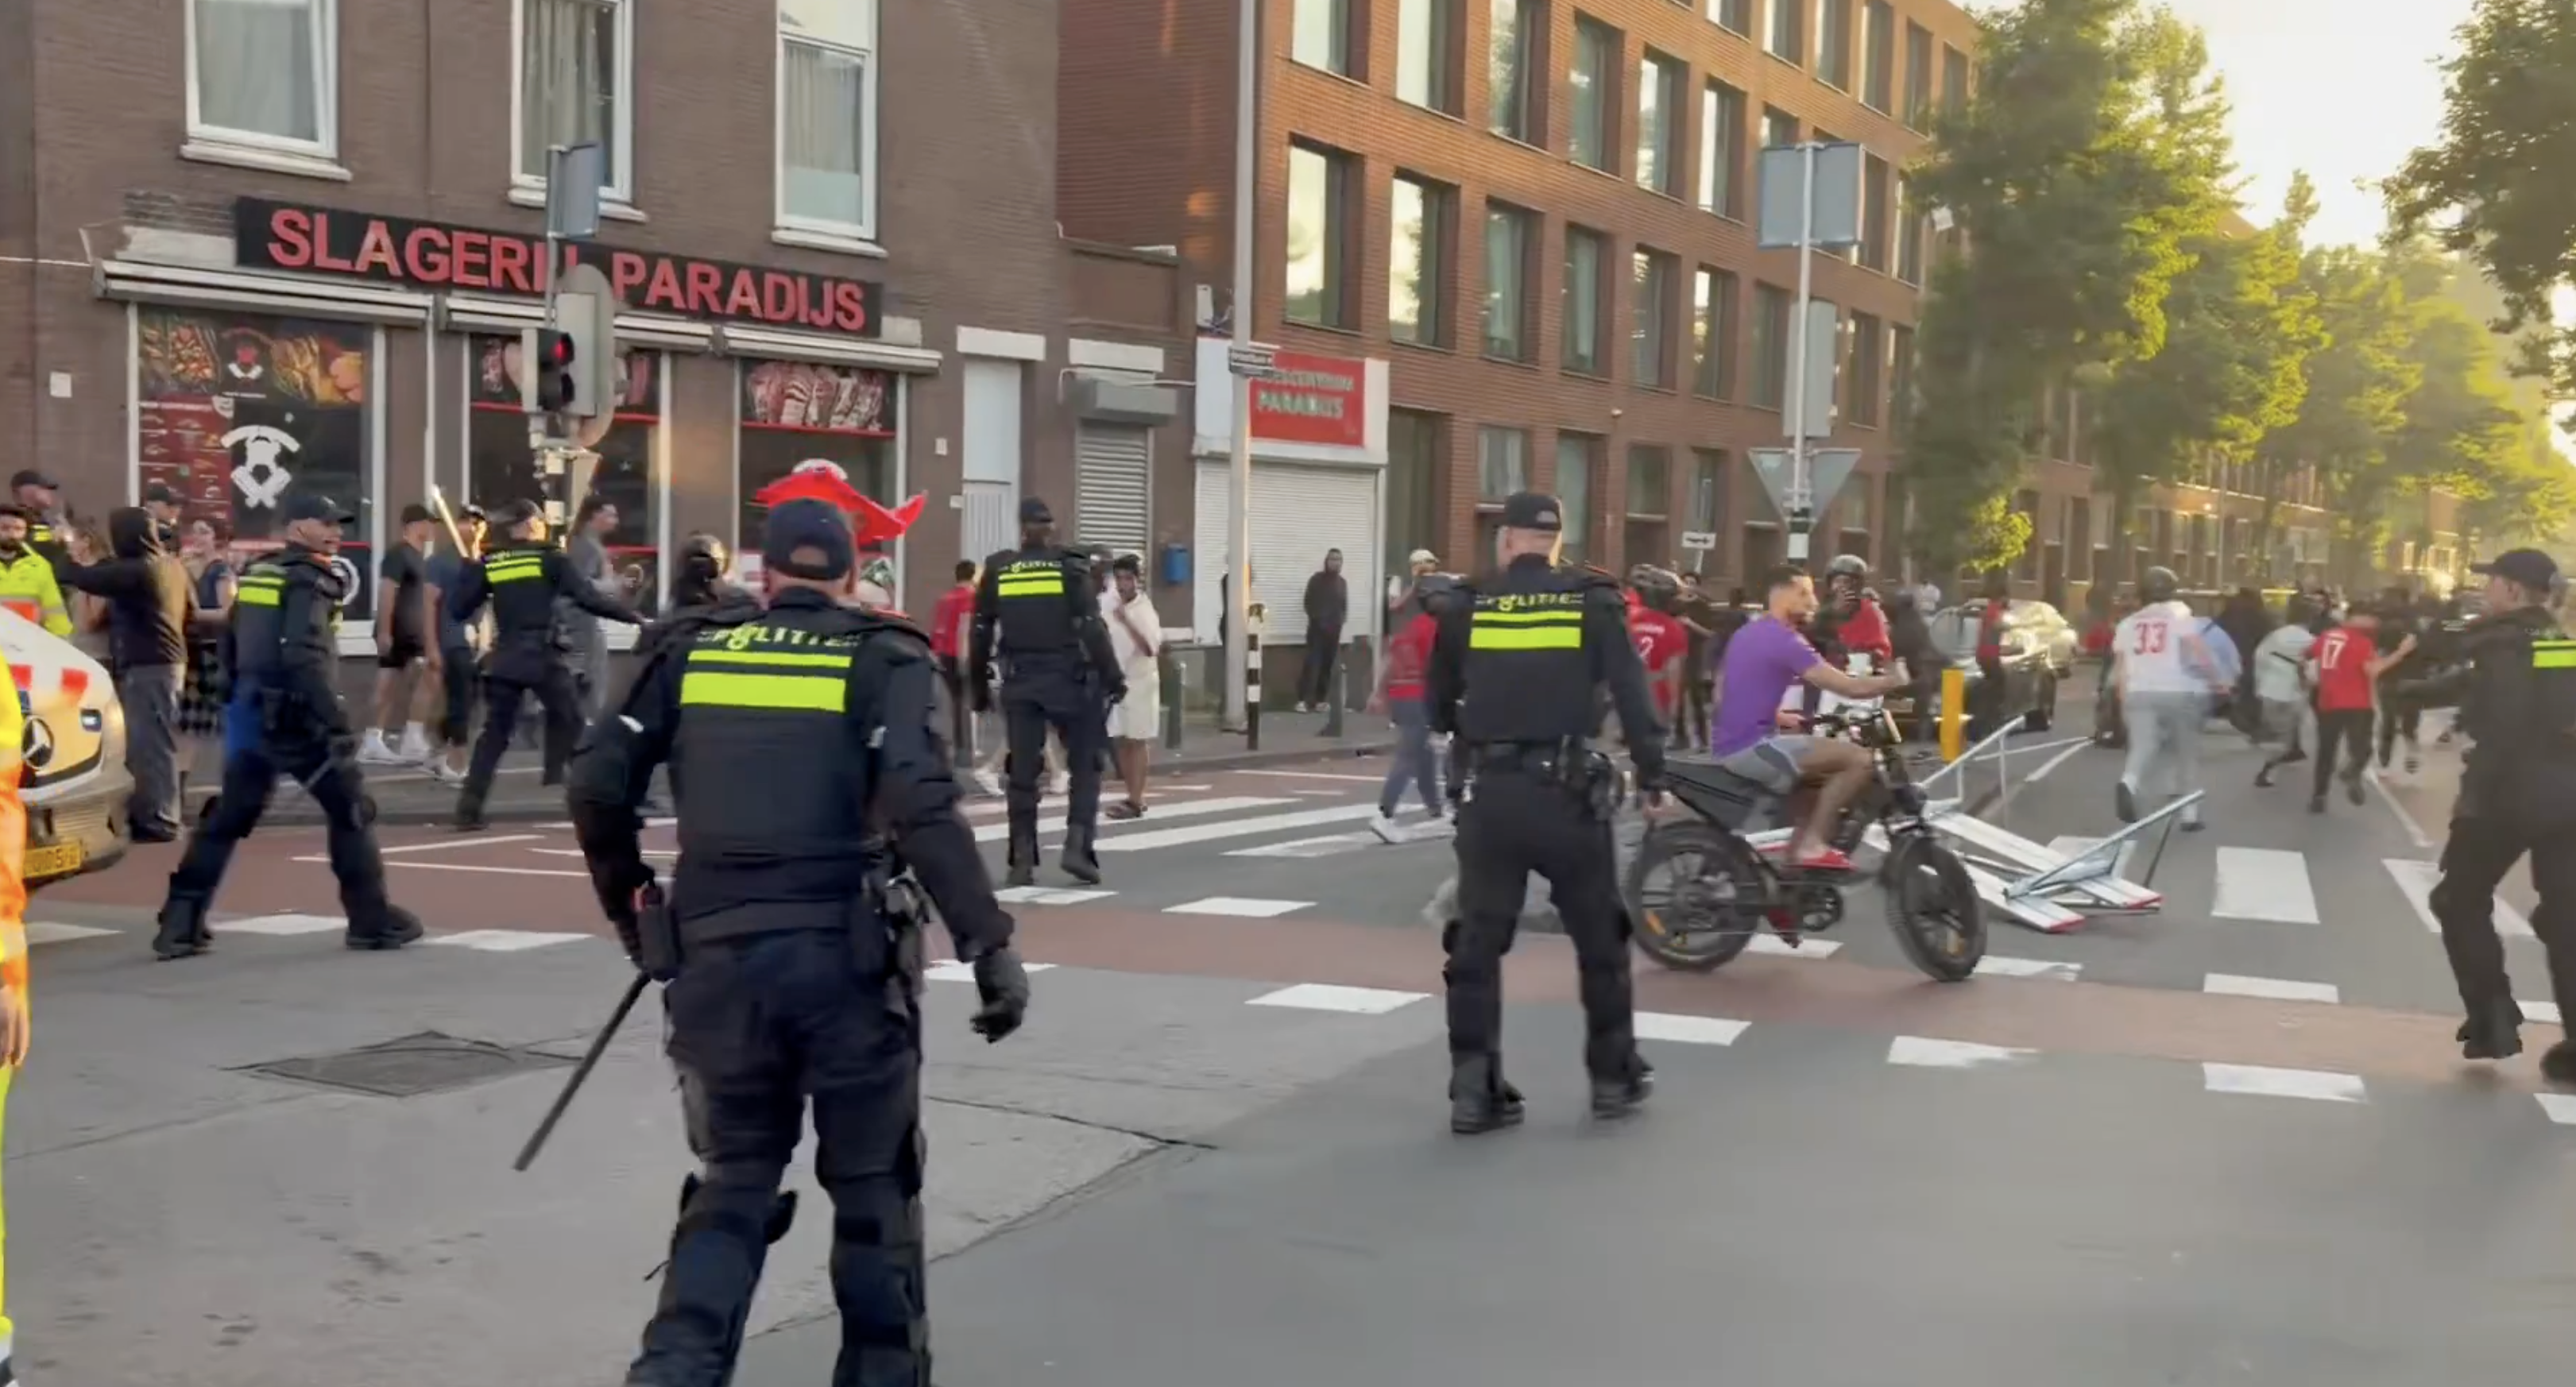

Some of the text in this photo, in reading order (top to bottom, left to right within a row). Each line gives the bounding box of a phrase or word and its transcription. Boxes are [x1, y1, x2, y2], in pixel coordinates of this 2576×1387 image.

[612, 251, 864, 331] PARADIJS
[709, 621, 851, 650] POLITIE
[2134, 620, 2168, 655] 33
[2322, 638, 2346, 669] 17
